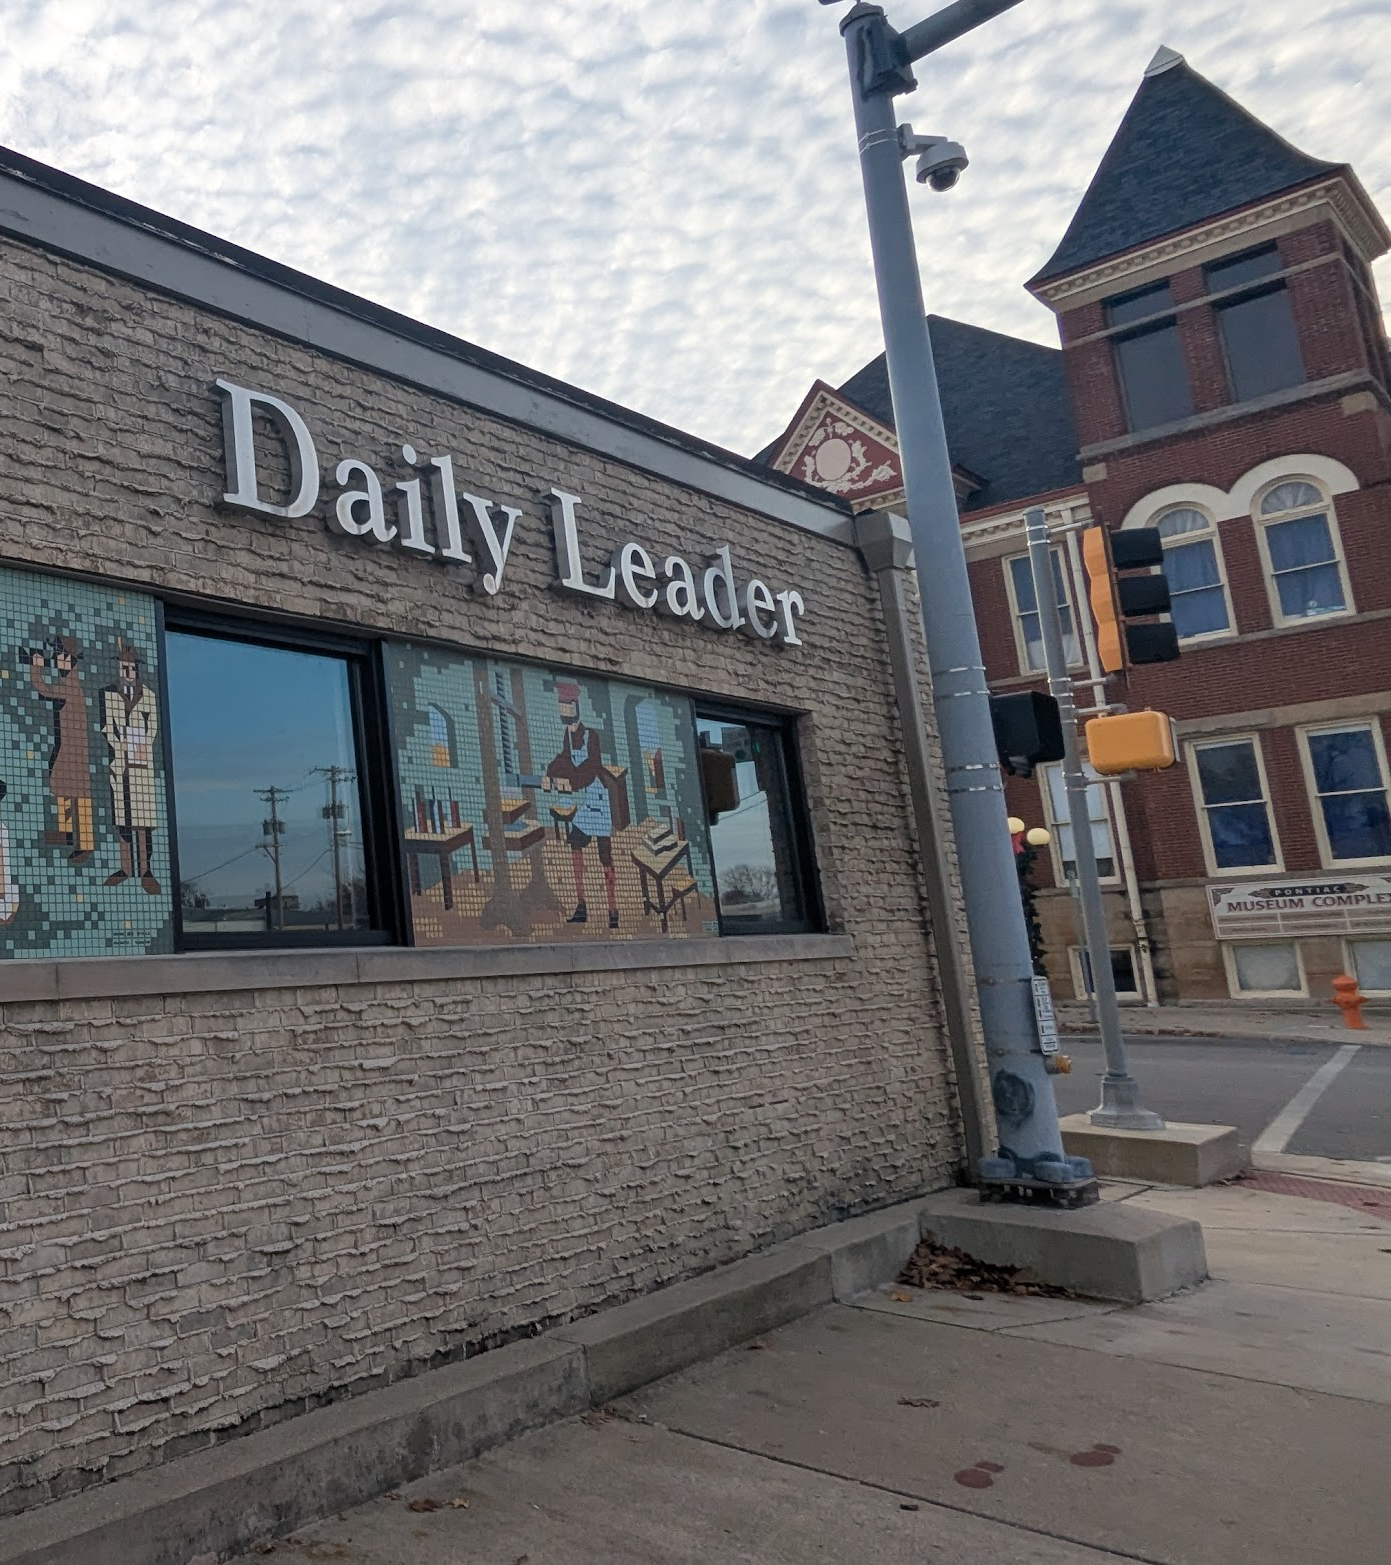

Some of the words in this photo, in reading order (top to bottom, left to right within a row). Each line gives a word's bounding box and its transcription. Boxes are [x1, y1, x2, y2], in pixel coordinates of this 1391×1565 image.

[215, 378, 523, 596] Daily
[550, 487, 805, 646] Leader
[1274, 885, 1341, 896] PONTIAC
[1227, 898, 1304, 912] MUSEUM
